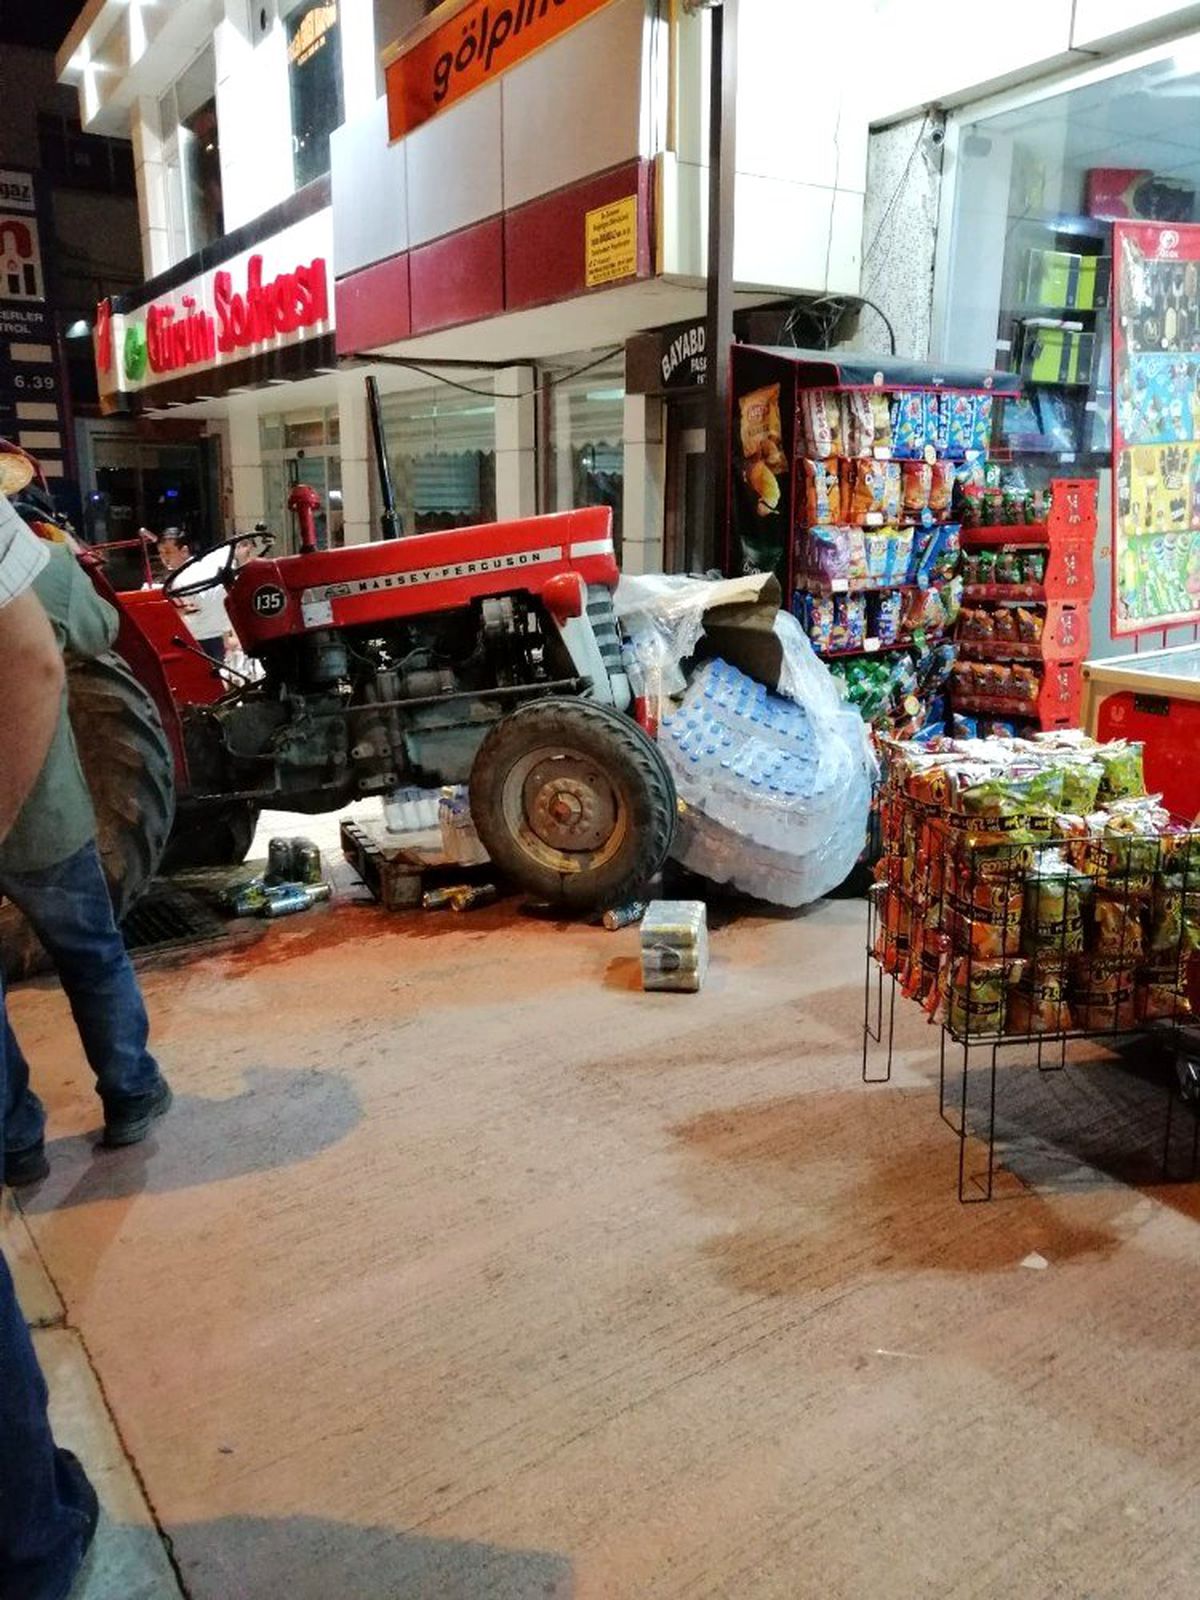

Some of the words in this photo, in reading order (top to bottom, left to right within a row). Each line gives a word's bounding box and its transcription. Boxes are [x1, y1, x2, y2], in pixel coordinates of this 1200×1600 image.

[433, 0, 567, 103] gölpin
[14, 375, 54, 389] 6.39
[256, 593, 281, 611] 135
